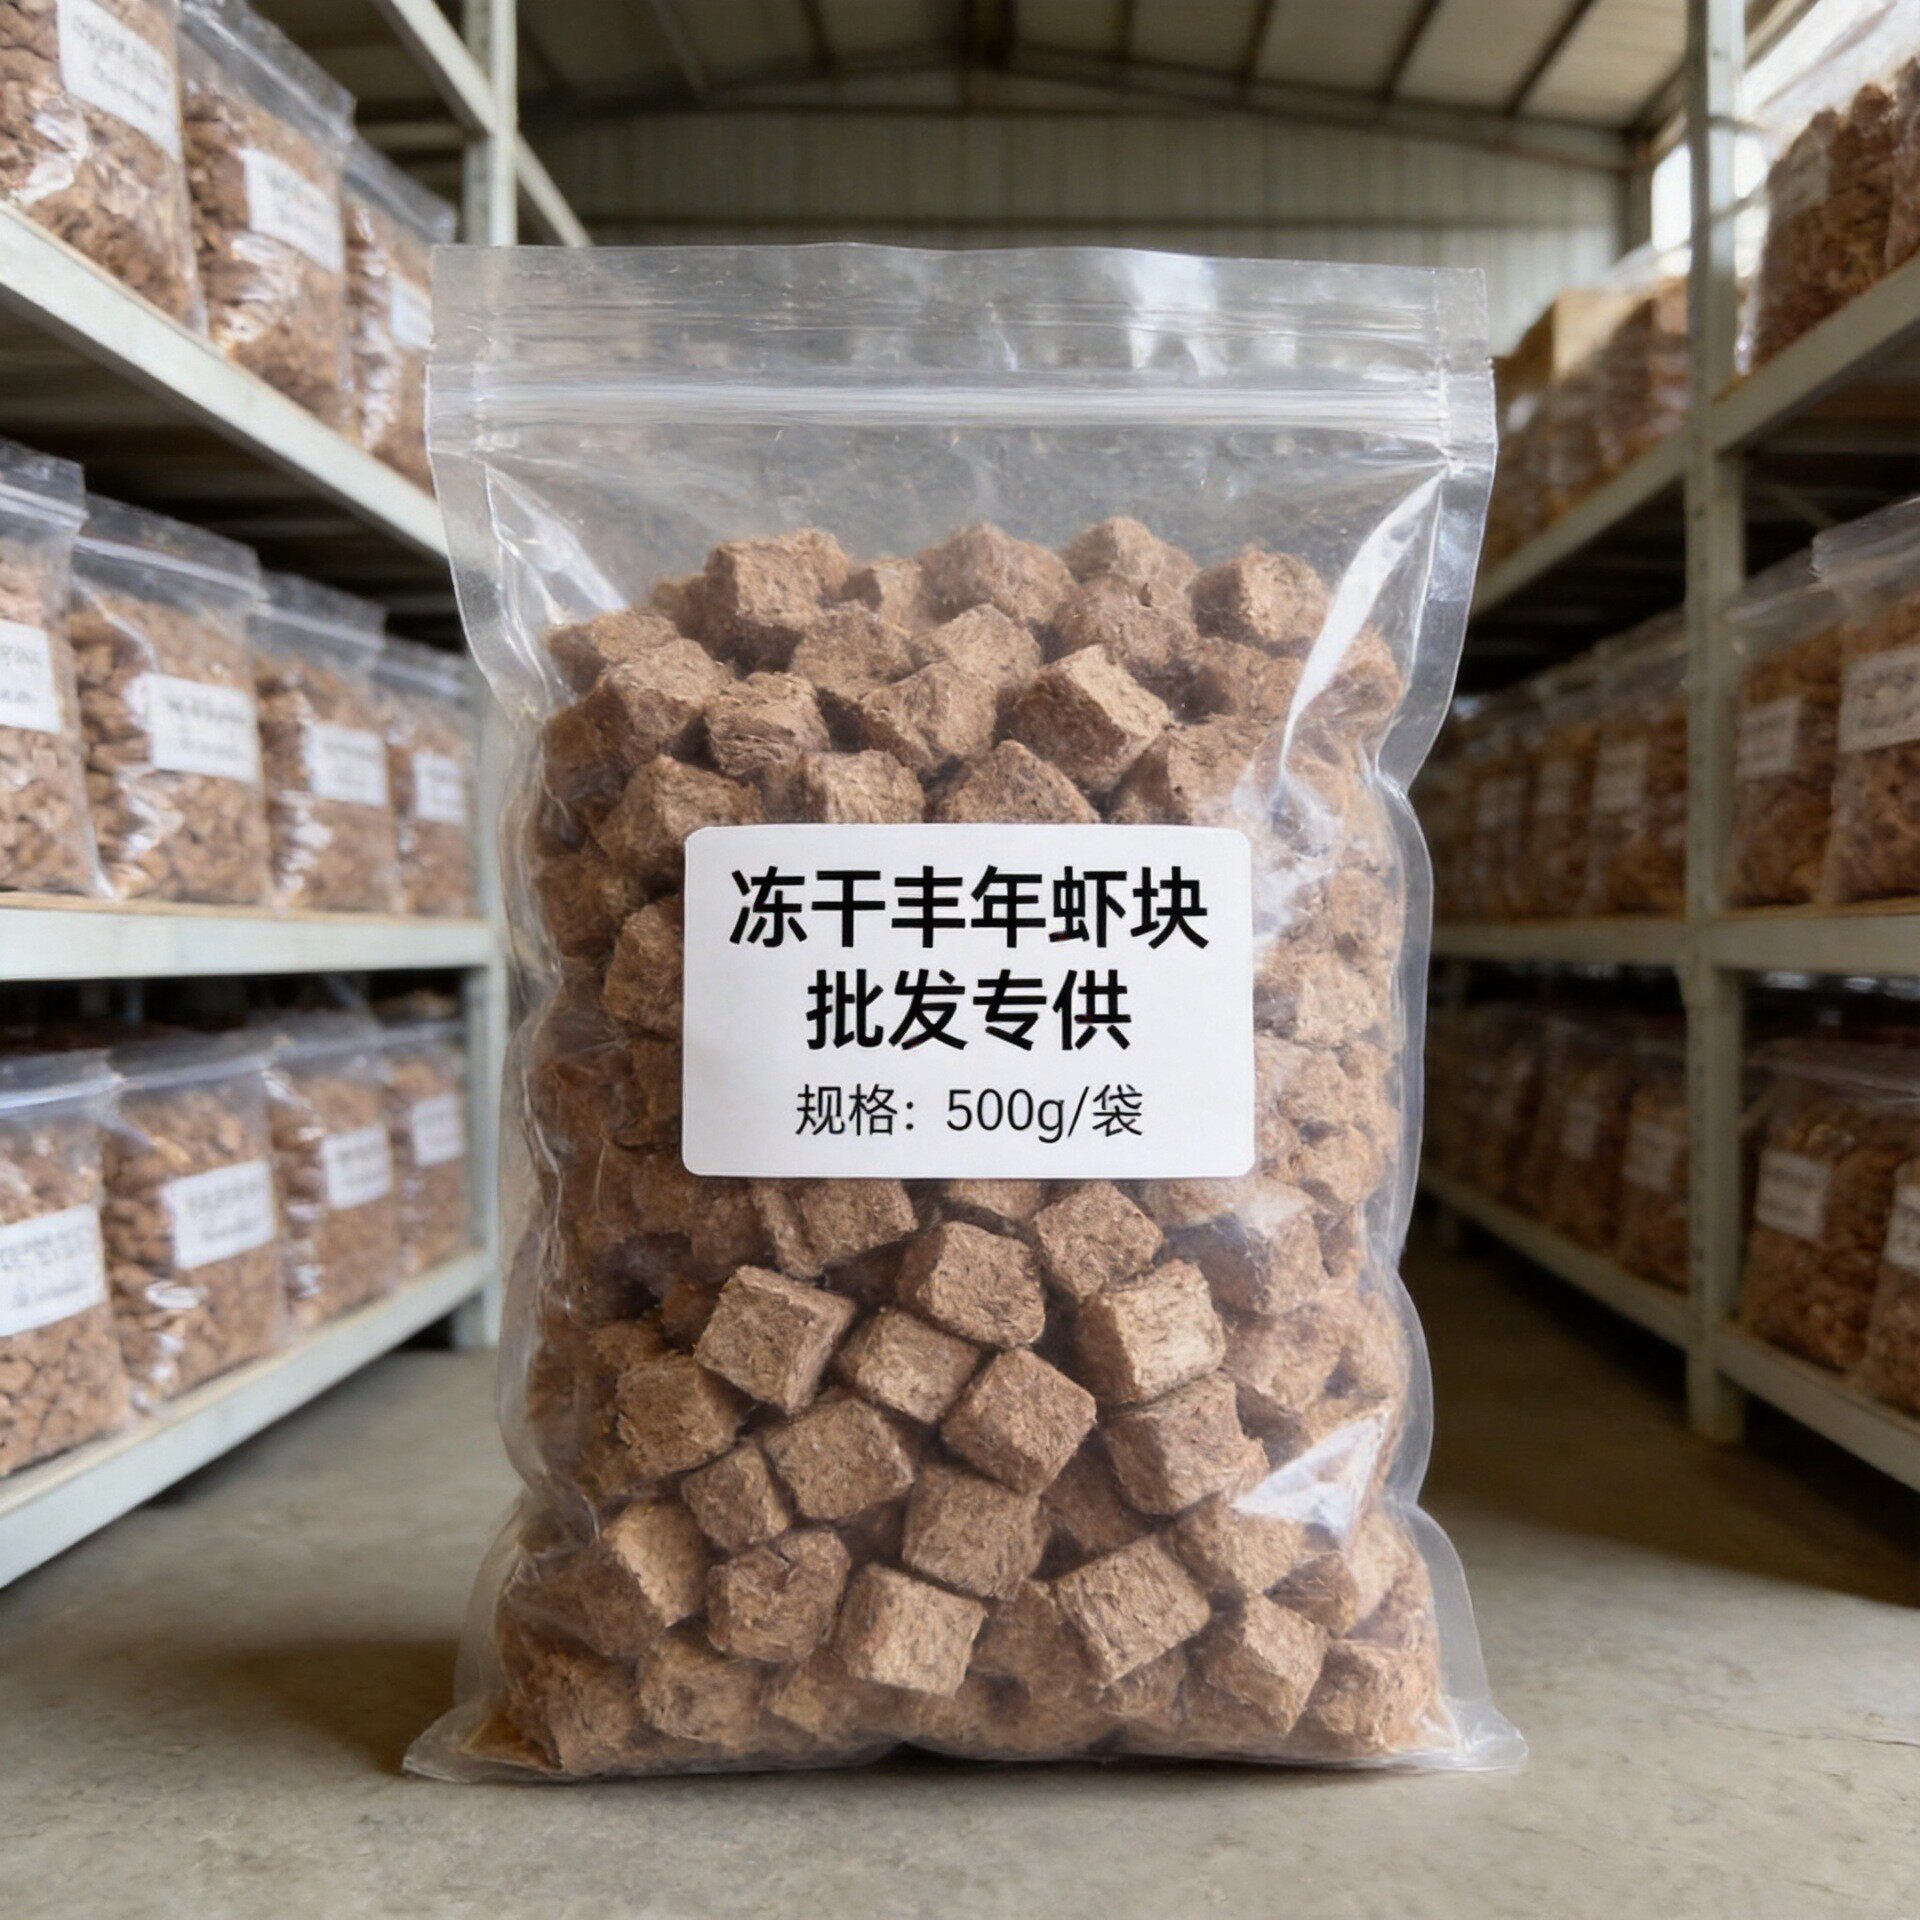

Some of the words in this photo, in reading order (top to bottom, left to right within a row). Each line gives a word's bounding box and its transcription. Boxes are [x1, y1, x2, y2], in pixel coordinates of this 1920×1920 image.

[729, 864, 1209, 950] 冻干丰年虾块
[805, 968, 1132, 1052] 批发专供
